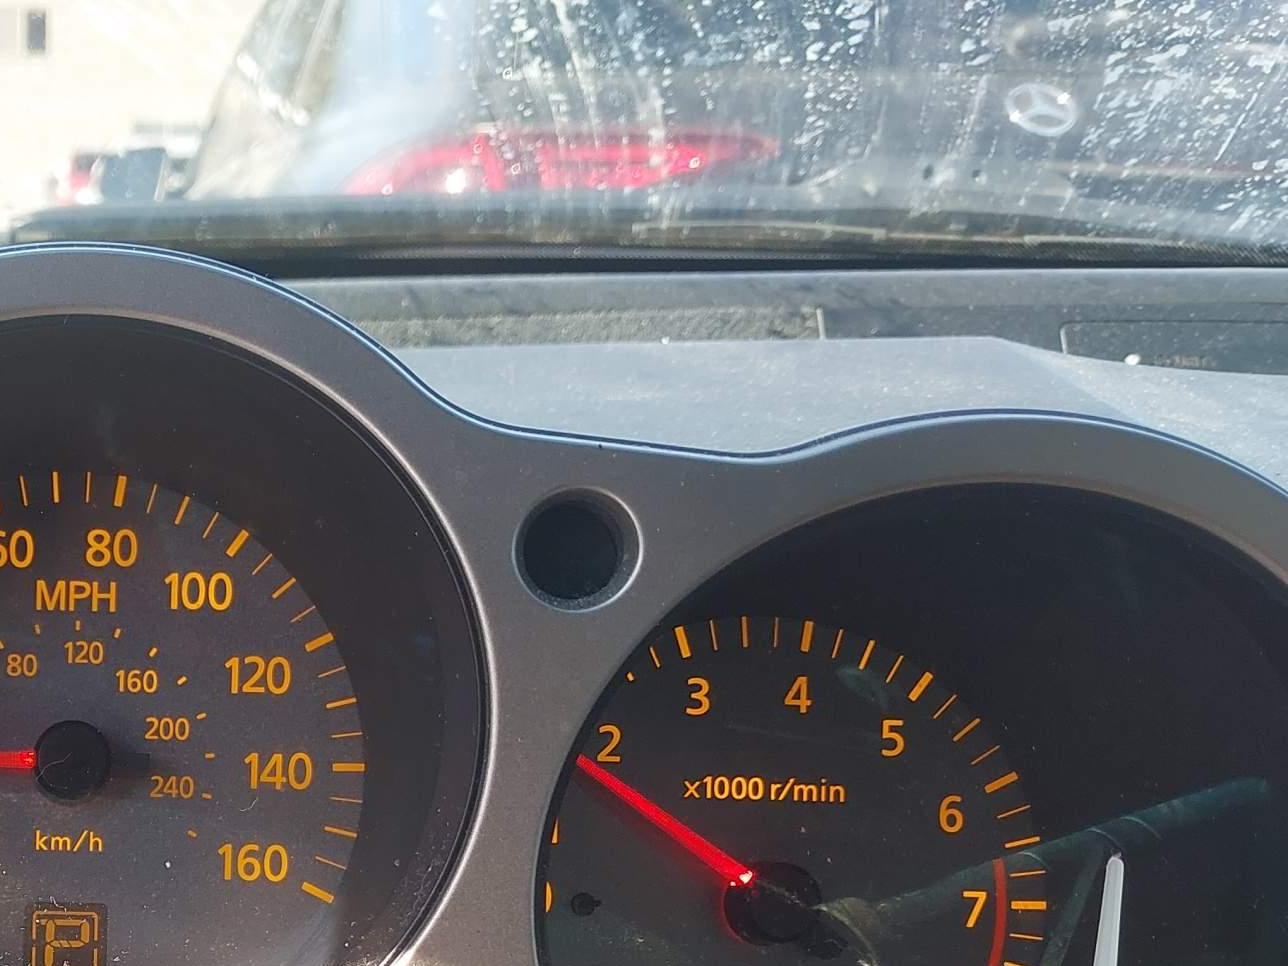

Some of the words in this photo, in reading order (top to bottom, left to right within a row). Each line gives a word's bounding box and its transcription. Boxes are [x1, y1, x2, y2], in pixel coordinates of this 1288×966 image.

[85, 528, 139, 568] 80
[35, 579, 118, 613] MPH
[163, 571, 234, 612] 100
[6, 653, 38, 677] 80
[64, 640, 105, 665] 120
[115, 669, 159, 694] 160
[224, 655, 292, 695] 120
[685, 677, 710, 716] 3
[784, 676, 812, 714] 4
[144, 716, 191, 741] 200
[596, 724, 621, 763] 2
[881, 719, 905, 757] 5
[151, 775, 195, 800] 240
[243, 751, 314, 791] 140
[683, 775, 765, 801] x1000
[770, 777, 845, 803] r/min
[939, 795, 964, 833] 6
[35, 829, 105, 852] km/h
[217, 842, 291, 885] 160
[962, 890, 988, 928] 7
